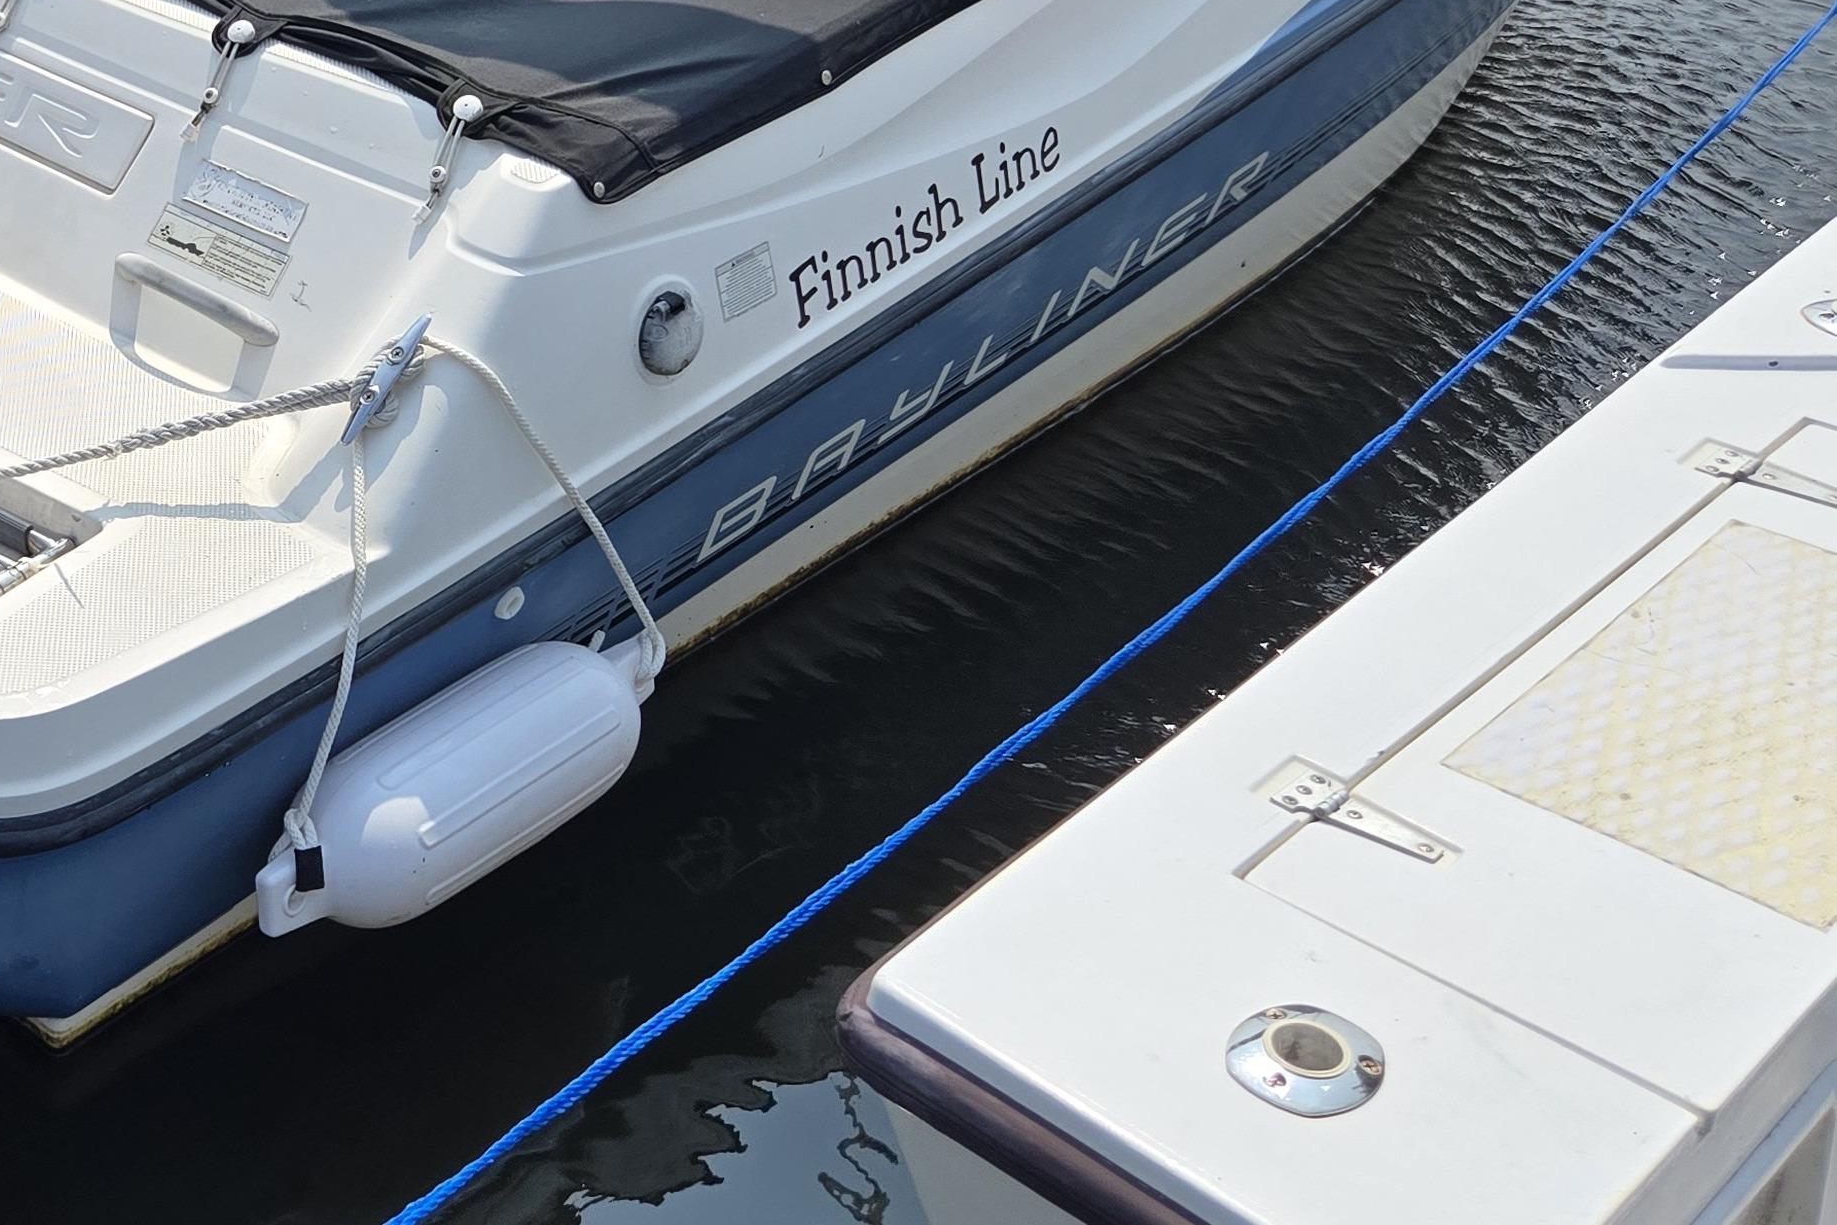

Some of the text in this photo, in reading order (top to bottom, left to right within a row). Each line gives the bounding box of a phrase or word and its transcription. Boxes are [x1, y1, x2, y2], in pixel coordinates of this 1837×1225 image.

[696, 150, 1270, 564] BAYLINER
[789, 183, 964, 329] Finnish
[971, 126, 1060, 215] Line
